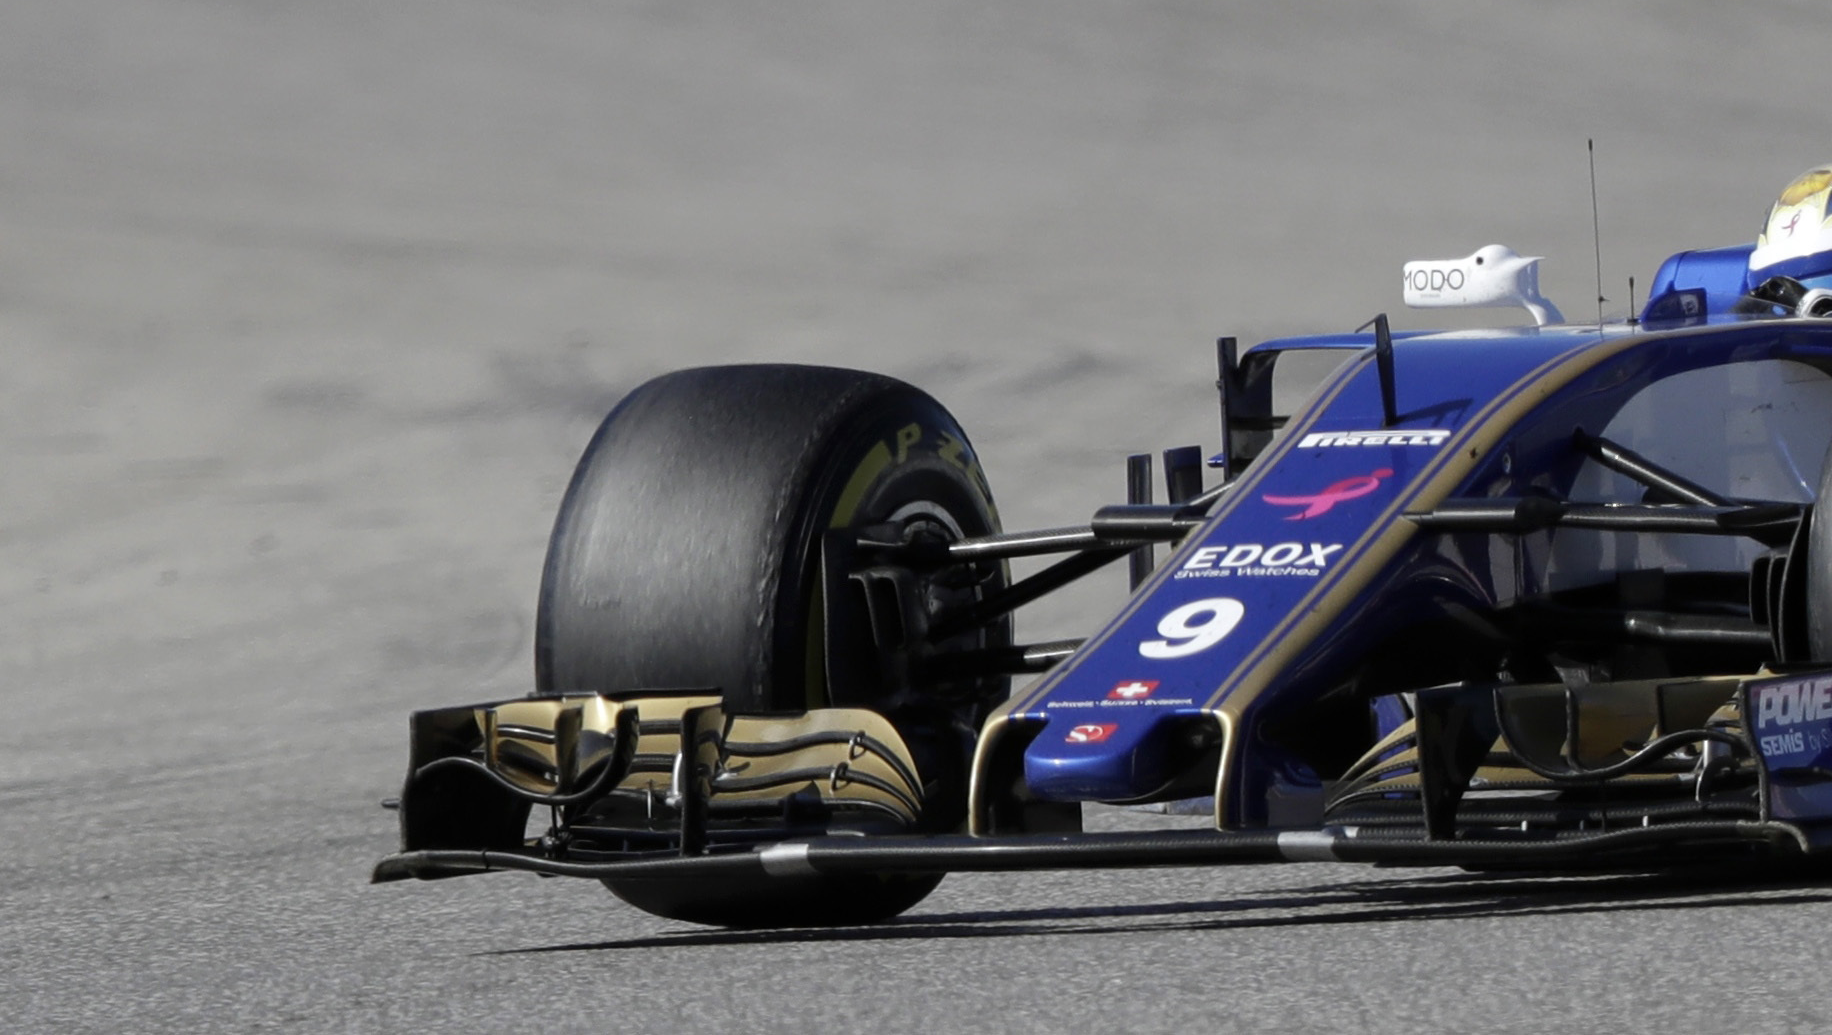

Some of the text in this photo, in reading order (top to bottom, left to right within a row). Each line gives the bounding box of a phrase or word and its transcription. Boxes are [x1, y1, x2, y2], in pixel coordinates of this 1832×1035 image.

[1297, 429, 1451, 448] PIRELLI
[1183, 541, 1344, 569] EDOX
[1174, 565, 1321, 580] Swiss Watches
[1138, 597, 1245, 659] 9
